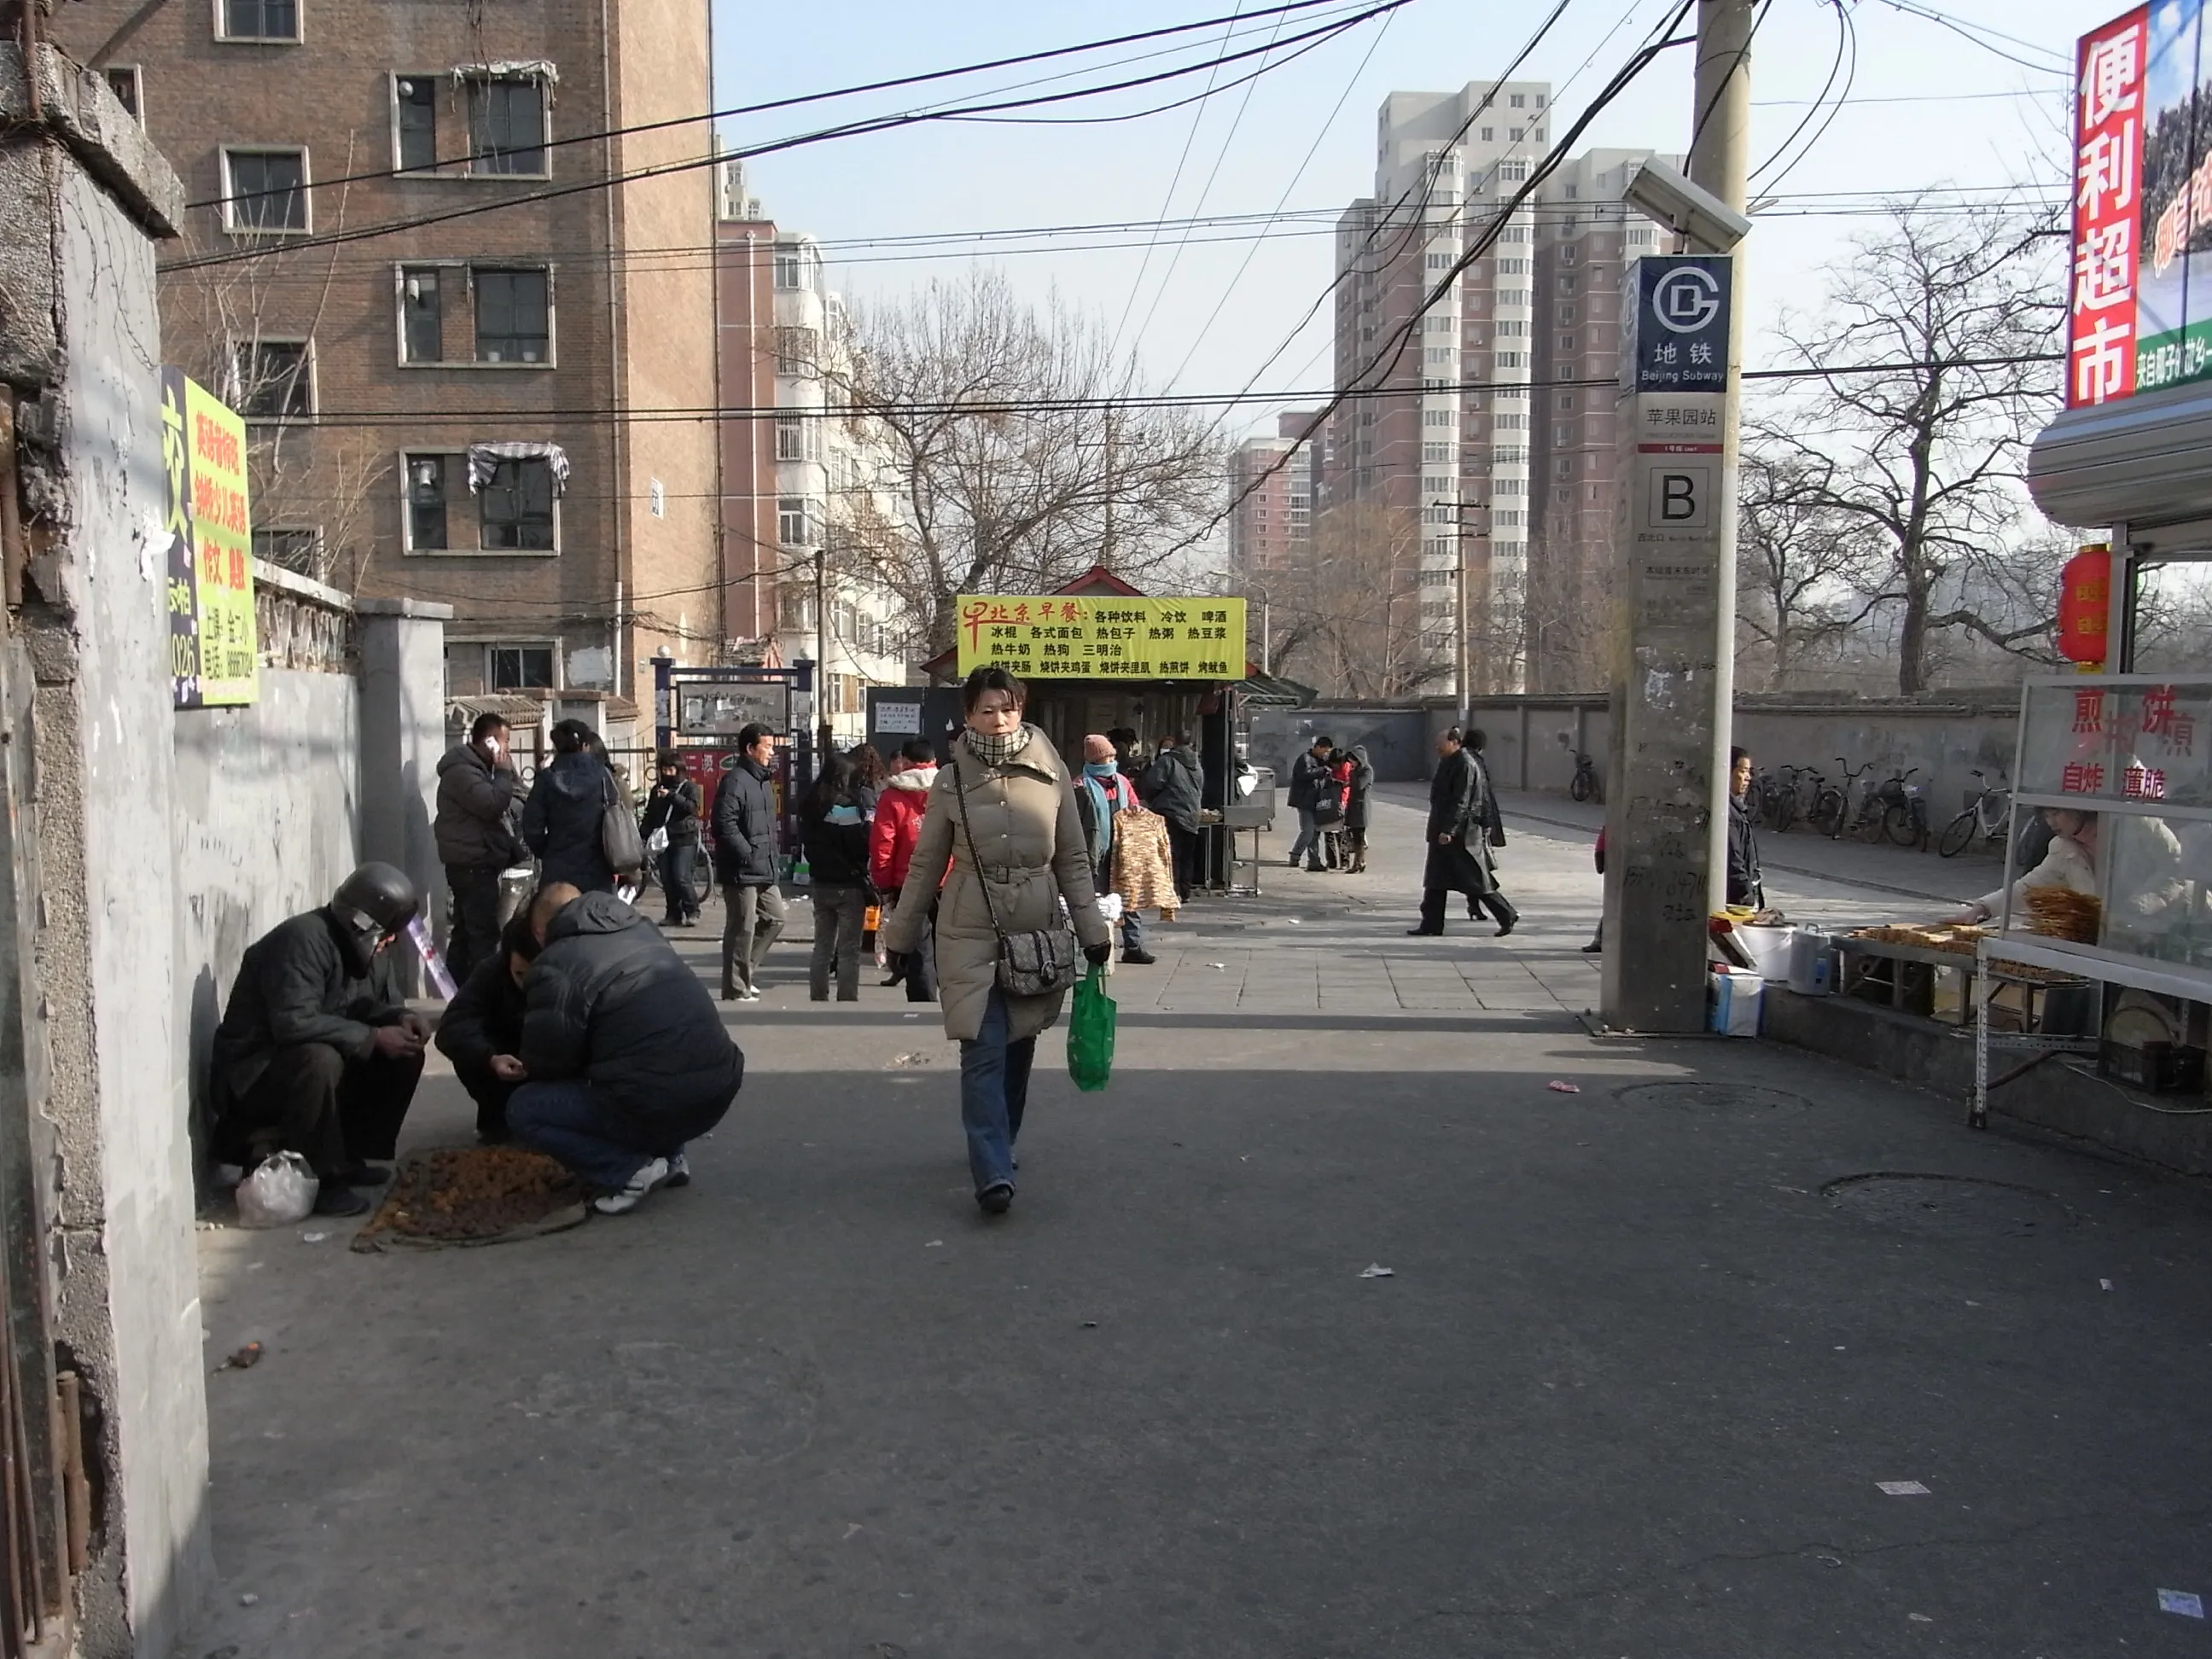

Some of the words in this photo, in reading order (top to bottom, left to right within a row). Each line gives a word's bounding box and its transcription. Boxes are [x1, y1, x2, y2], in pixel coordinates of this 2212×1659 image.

[2073, 24, 2139, 406] 便利超市
[1654, 342, 1712, 364] 地铁
[1642, 370, 1679, 382] Beijing
[1682, 370, 1724, 382] Subway
[1647, 409, 1716, 425] 苹果园站
[1662, 474, 1696, 520] B
[1638, 533, 1664, 542] 西北口
[1095, 610, 1146, 623] 各种饮料
[1161, 610, 1187, 623] 冷饮
[1202, 610, 1227, 623] 啤酒
[991, 626, 1017, 638] 冰棍
[1030, 626, 1083, 639] 各式面包
[1096, 627, 1136, 640] 热包子
[1149, 627, 1174, 639] 热粥
[1187, 627, 1227, 639] 热豆浆
[991, 643, 1031, 655] 热牛奶
[1044, 643, 1070, 655] 热狗
[1083, 643, 1122, 656] 三明治
[1039, 661, 1091, 673] 烧饼夹鸡蛋
[1159, 661, 1190, 674] 热煎饼
[1198, 661, 1229, 674] 烤鱿鱼
[2063, 762, 2104, 794] 自炸
[2122, 765, 2168, 800] 薄脆
